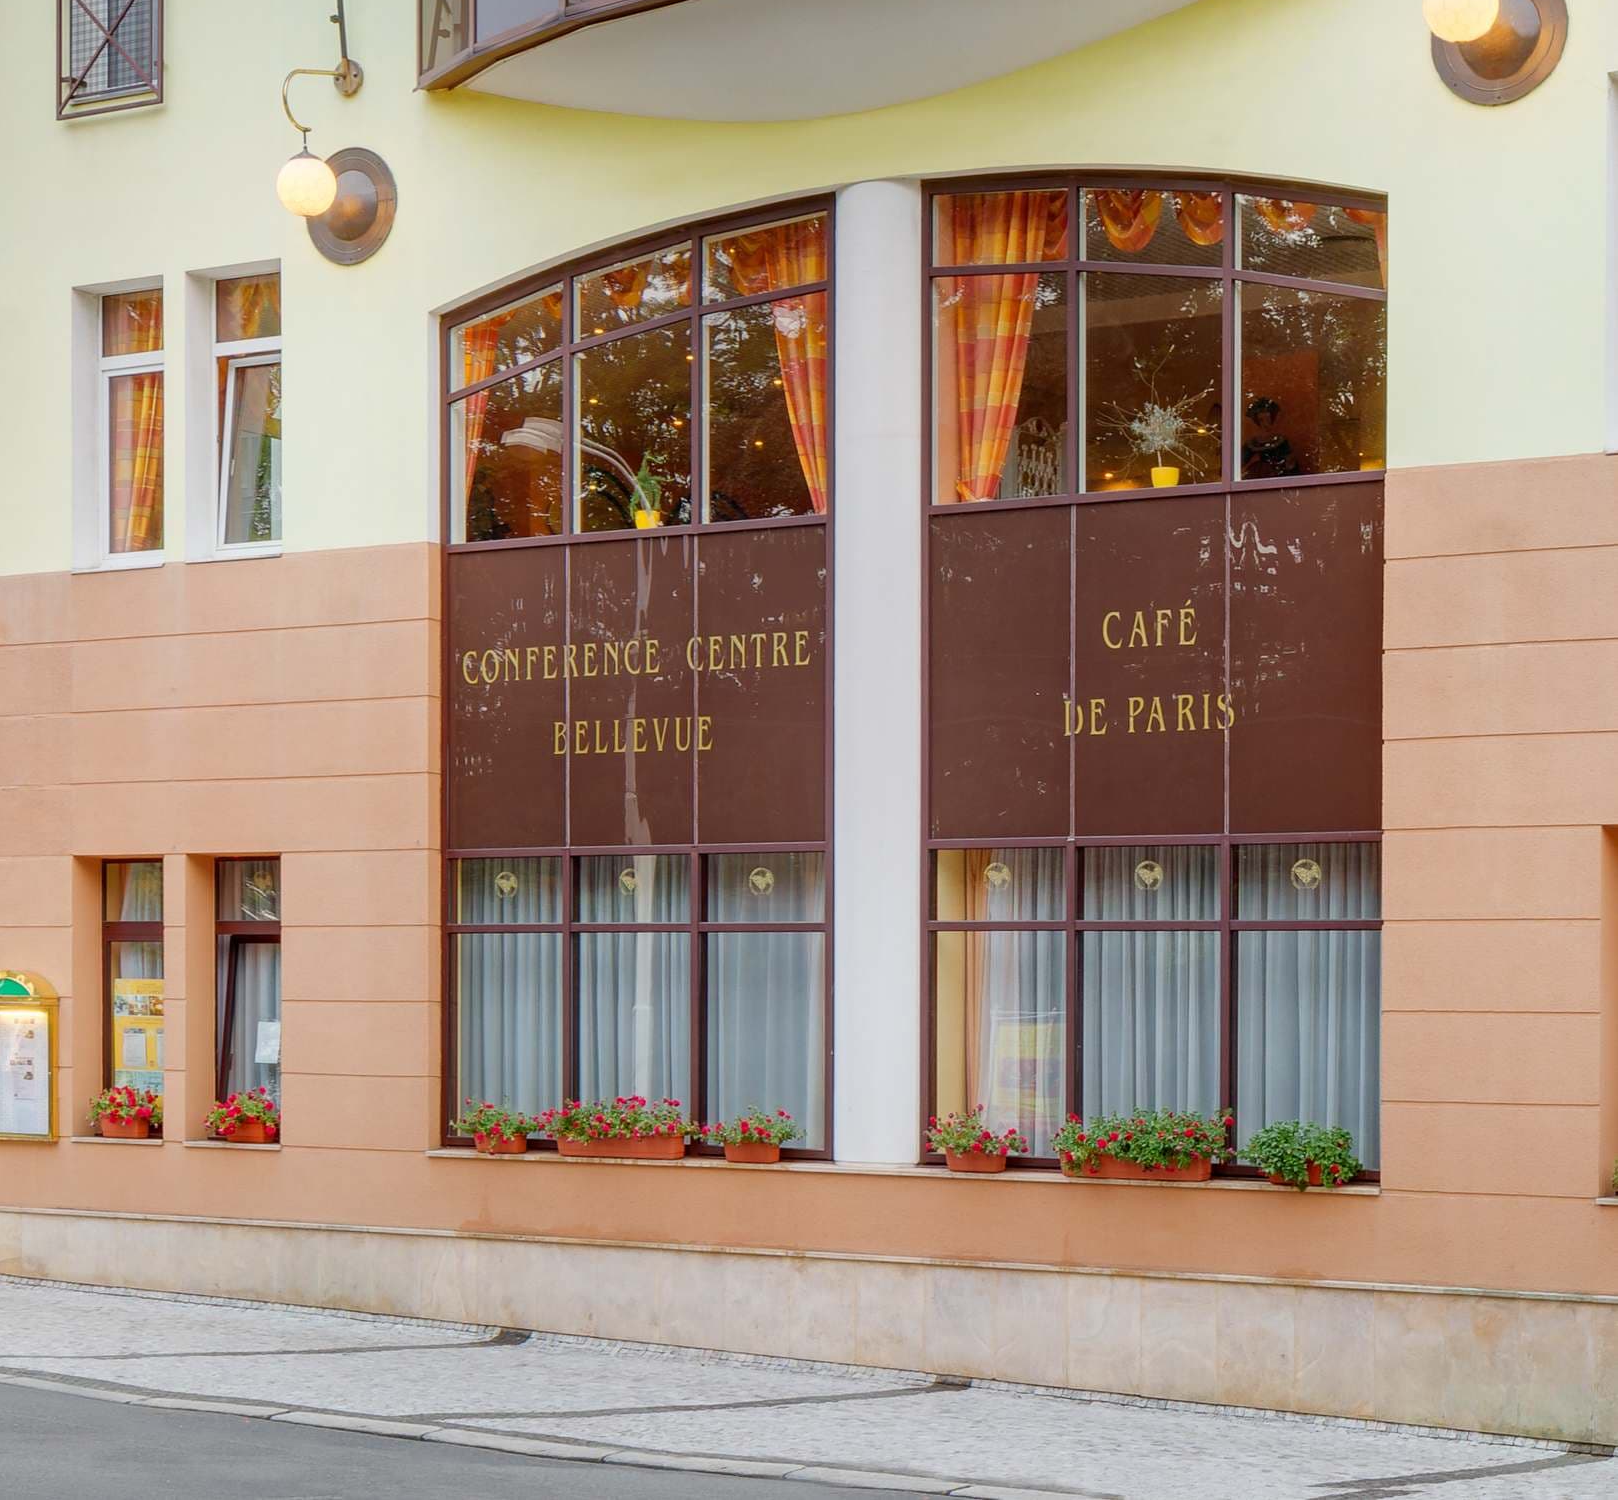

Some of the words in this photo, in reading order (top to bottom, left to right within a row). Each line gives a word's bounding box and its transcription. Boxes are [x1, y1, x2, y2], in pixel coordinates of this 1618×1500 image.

[1102, 600, 1198, 649] CAFÉ
[462, 638, 661, 685] CONFERENCE
[686, 630, 811, 672] CENTRE
[553, 715, 714, 755] BELLEVUE
[1063, 698, 1108, 737] DE
[1127, 692, 1236, 734] PARIS
